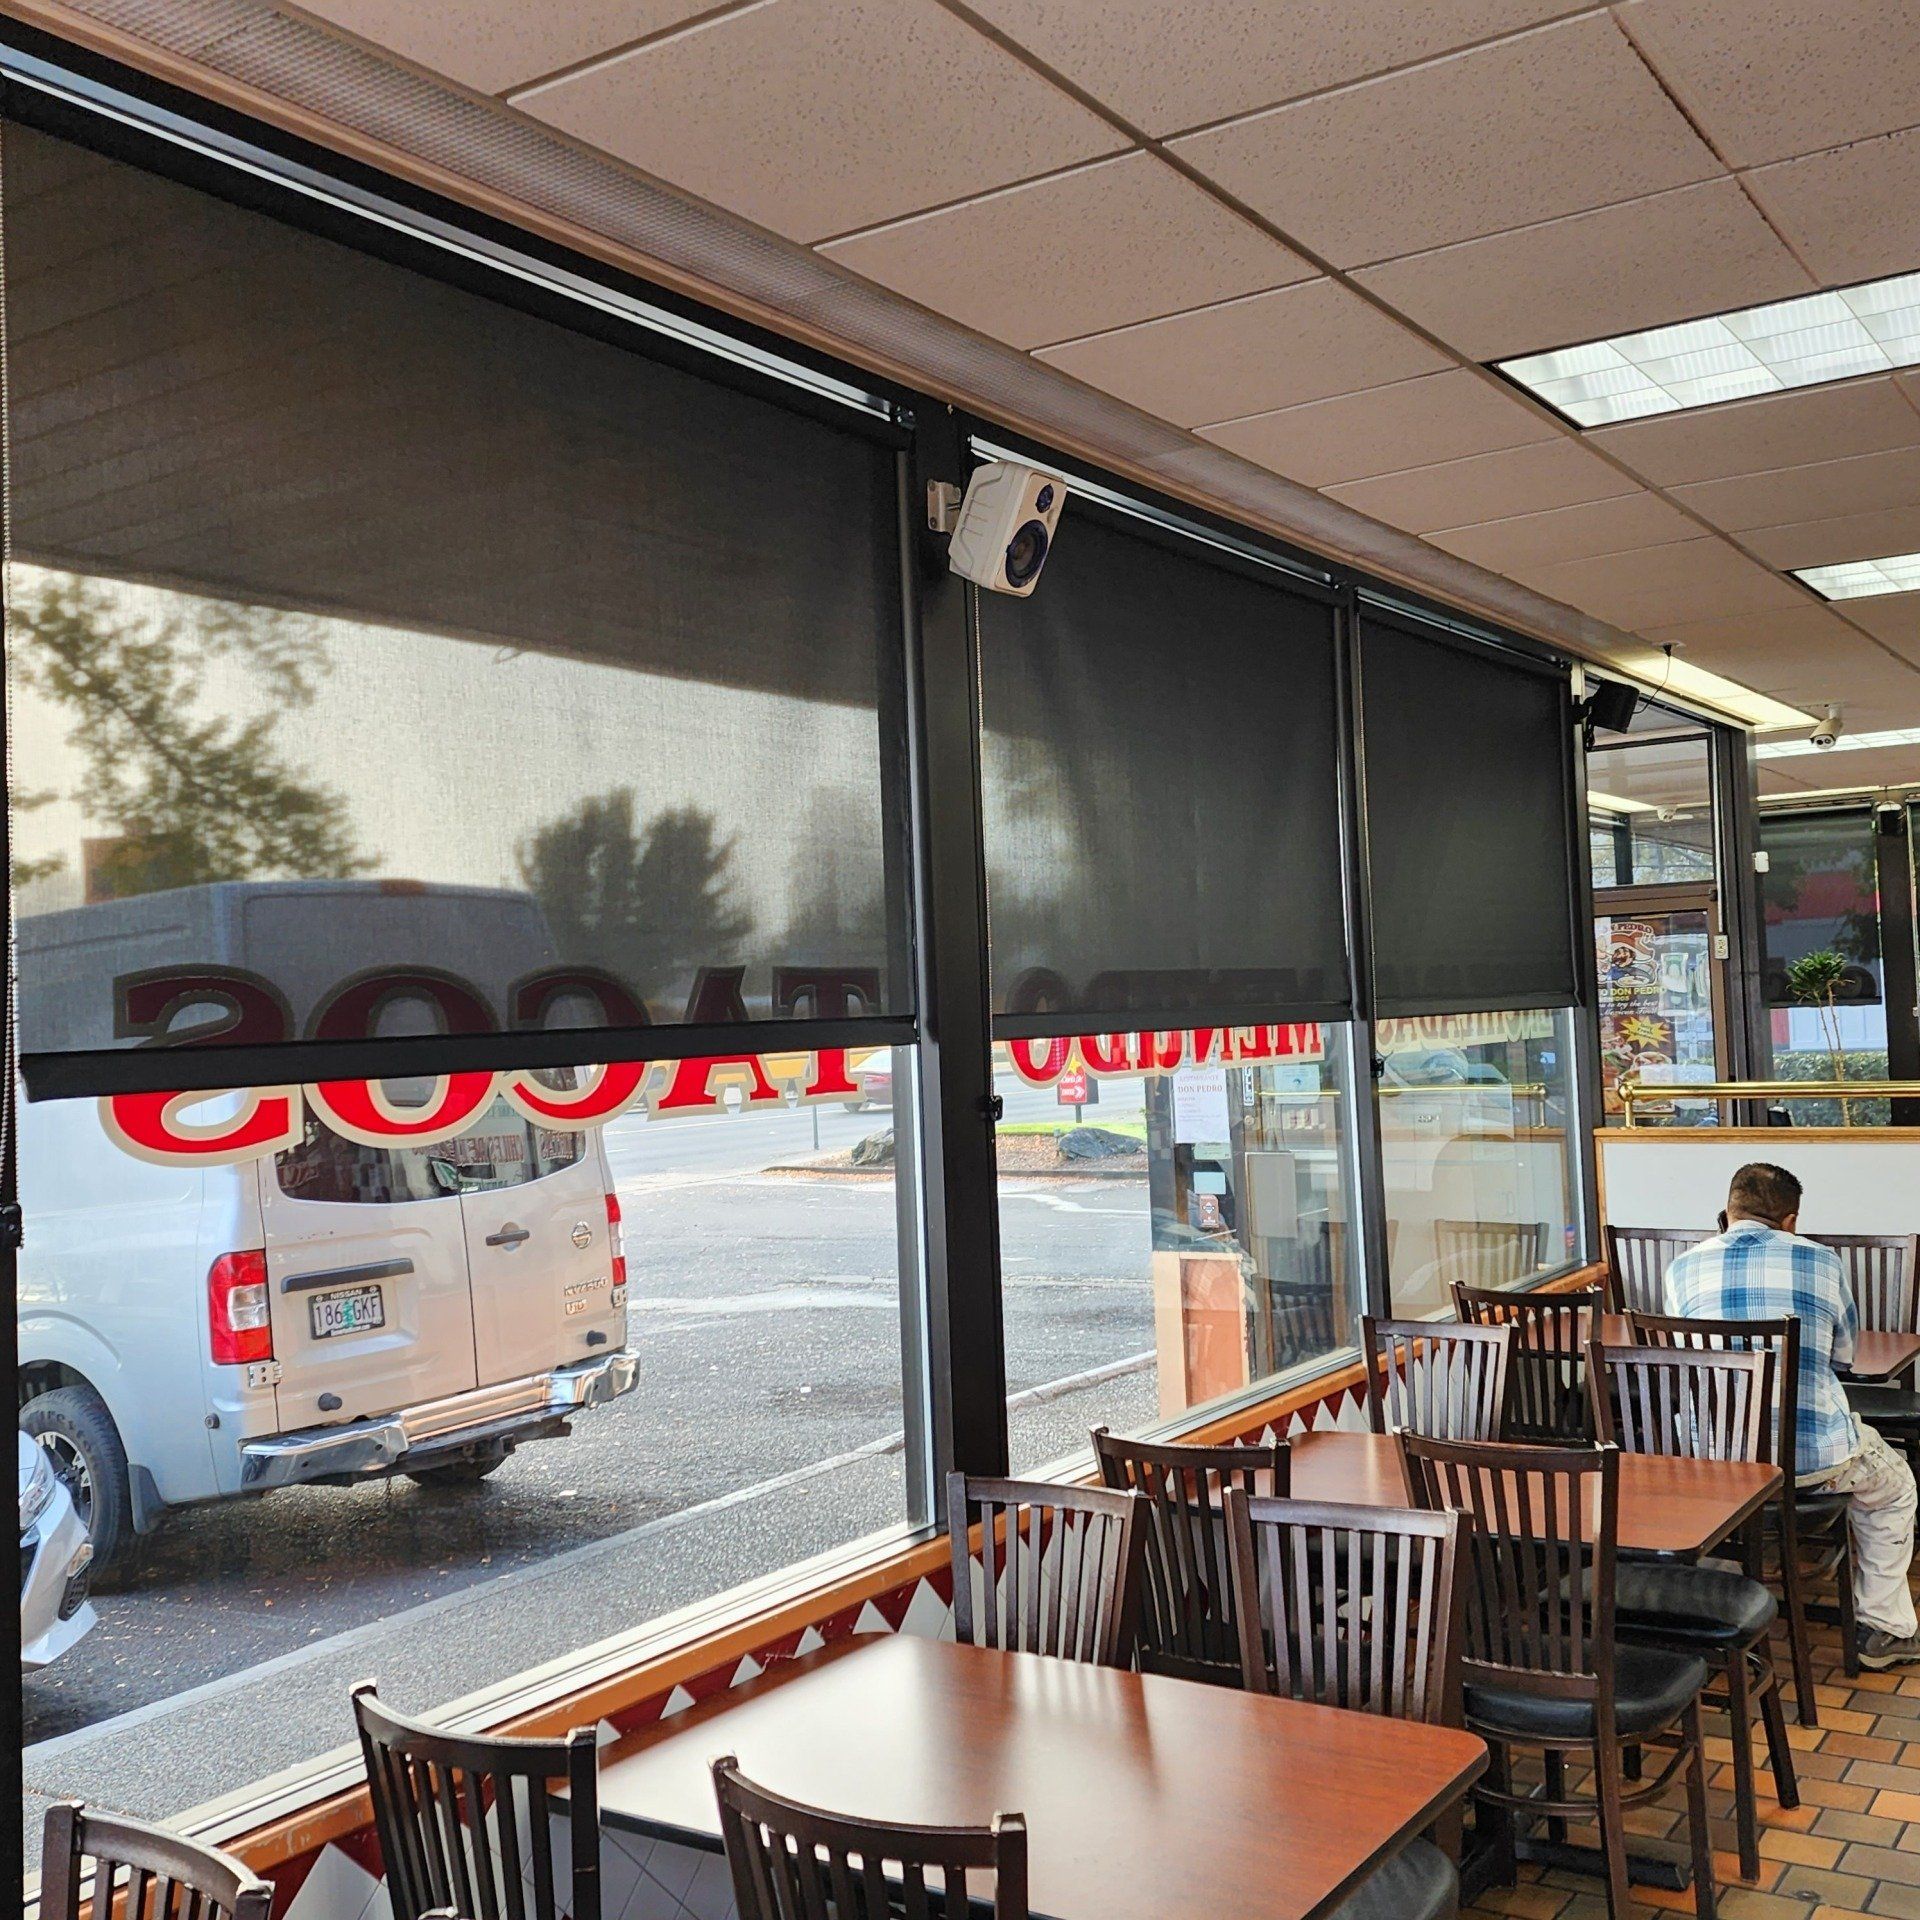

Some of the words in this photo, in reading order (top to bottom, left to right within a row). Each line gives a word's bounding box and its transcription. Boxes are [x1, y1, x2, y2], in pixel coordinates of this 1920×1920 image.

[1177, 1085, 1195, 1093] DON
[1196, 1084, 1223, 1093] PEDRO
[330, 1289, 363, 1300] NISSAN
